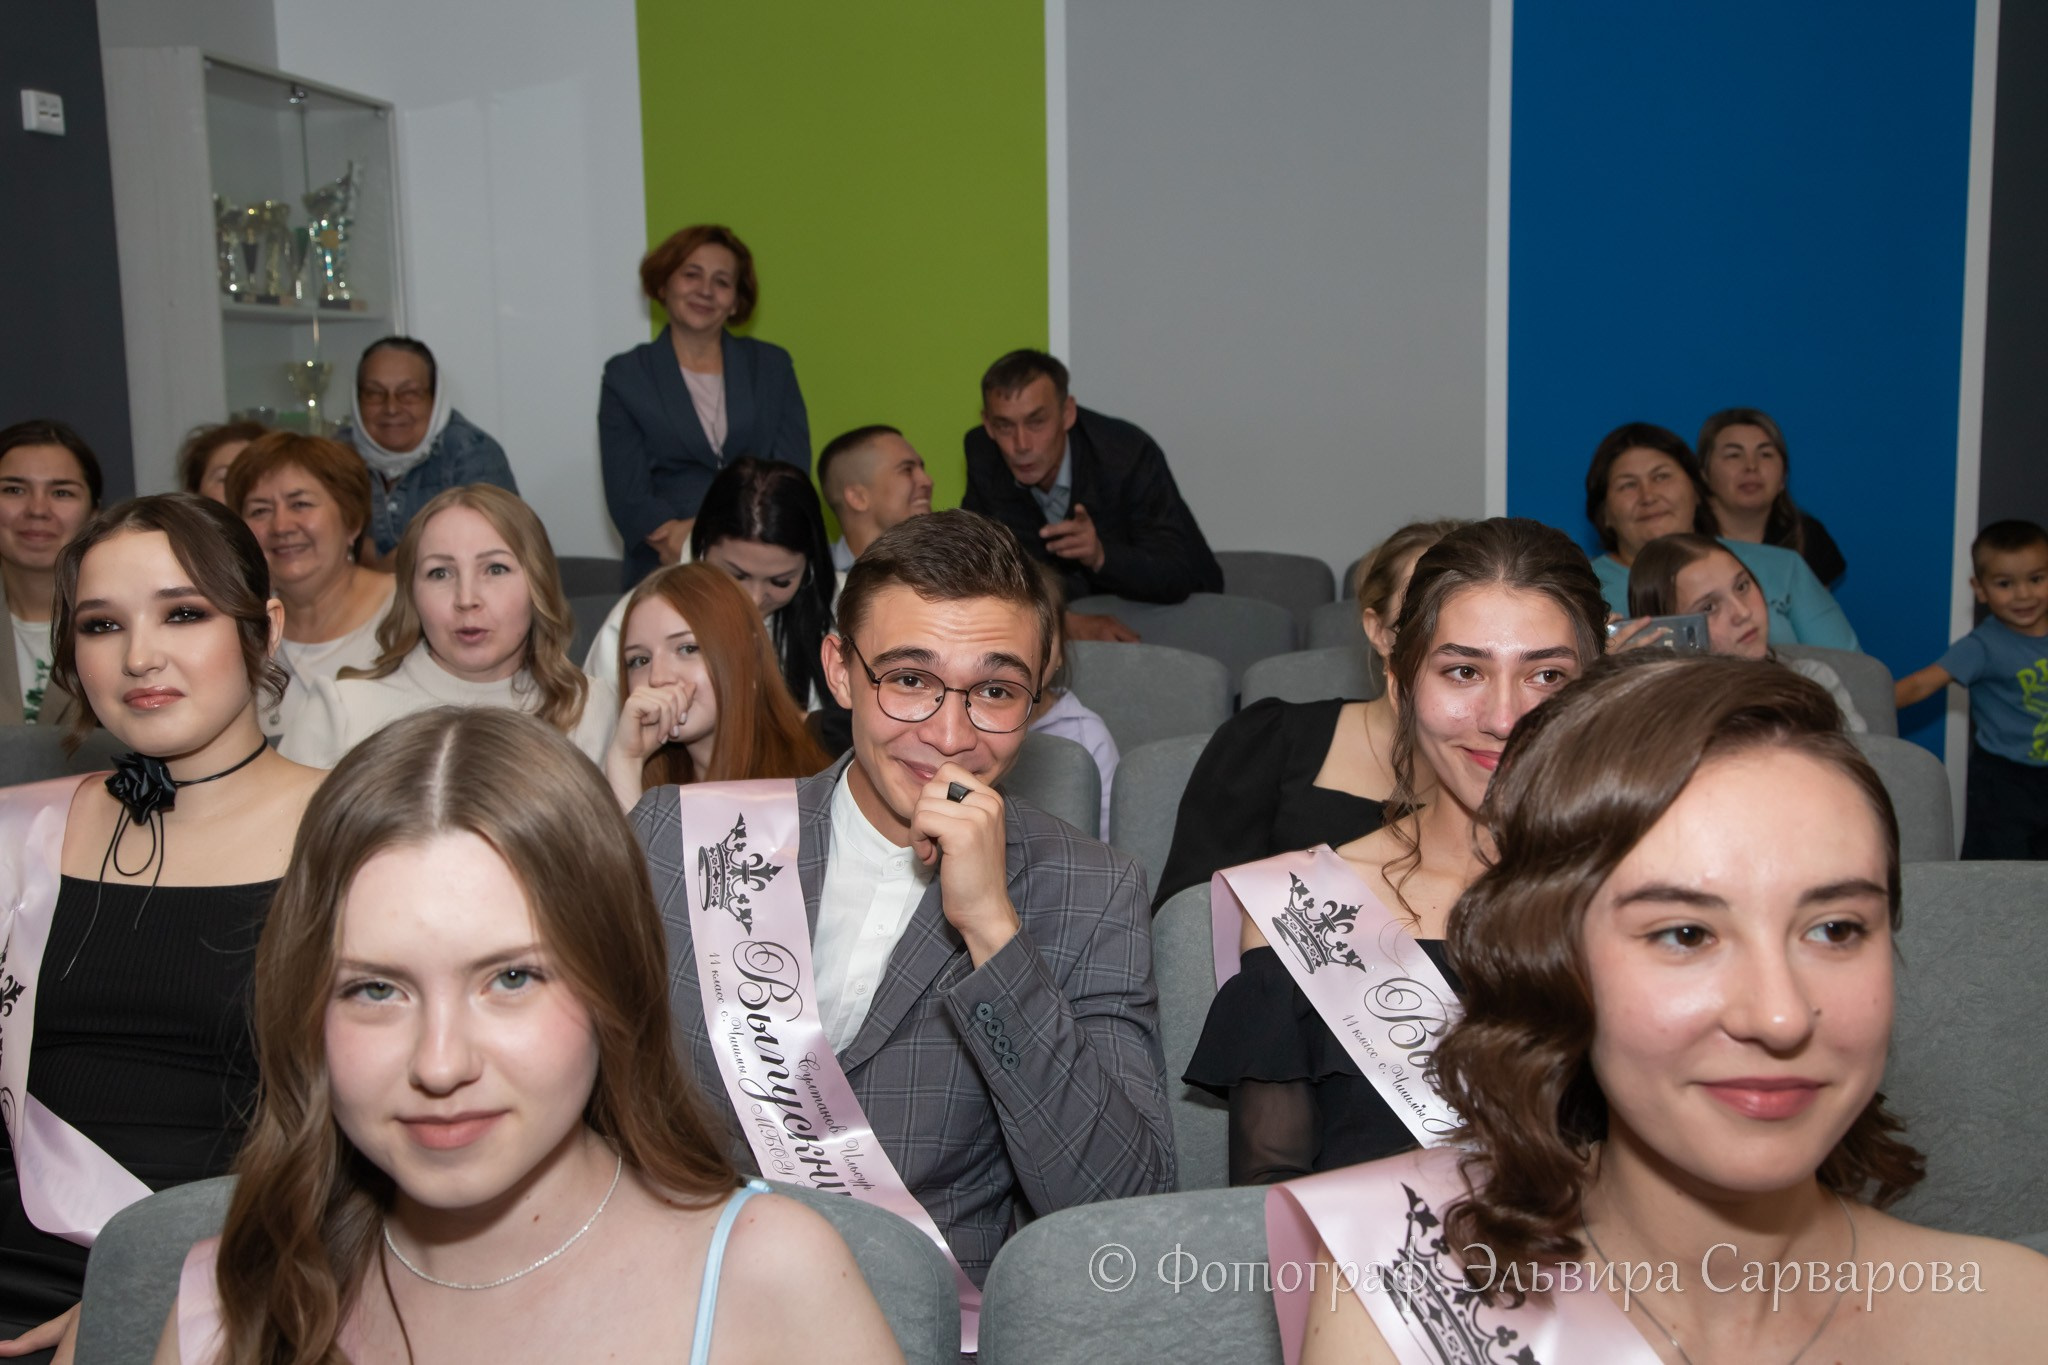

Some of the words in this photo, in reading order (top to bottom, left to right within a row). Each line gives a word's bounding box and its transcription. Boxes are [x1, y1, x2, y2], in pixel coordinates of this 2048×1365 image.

[708, 952, 720, 965] 11
[711, 970, 725, 1005] класс
[727, 1016, 747, 1076] Чишмы
[1342, 1014, 1359, 1031] 11
[1352, 1028, 1378, 1060] класс
[732, 940, 852, 1197] Выпускни
[798, 1051, 848, 1135] Султанов
[840, 1137, 876, 1192] Ильсур
